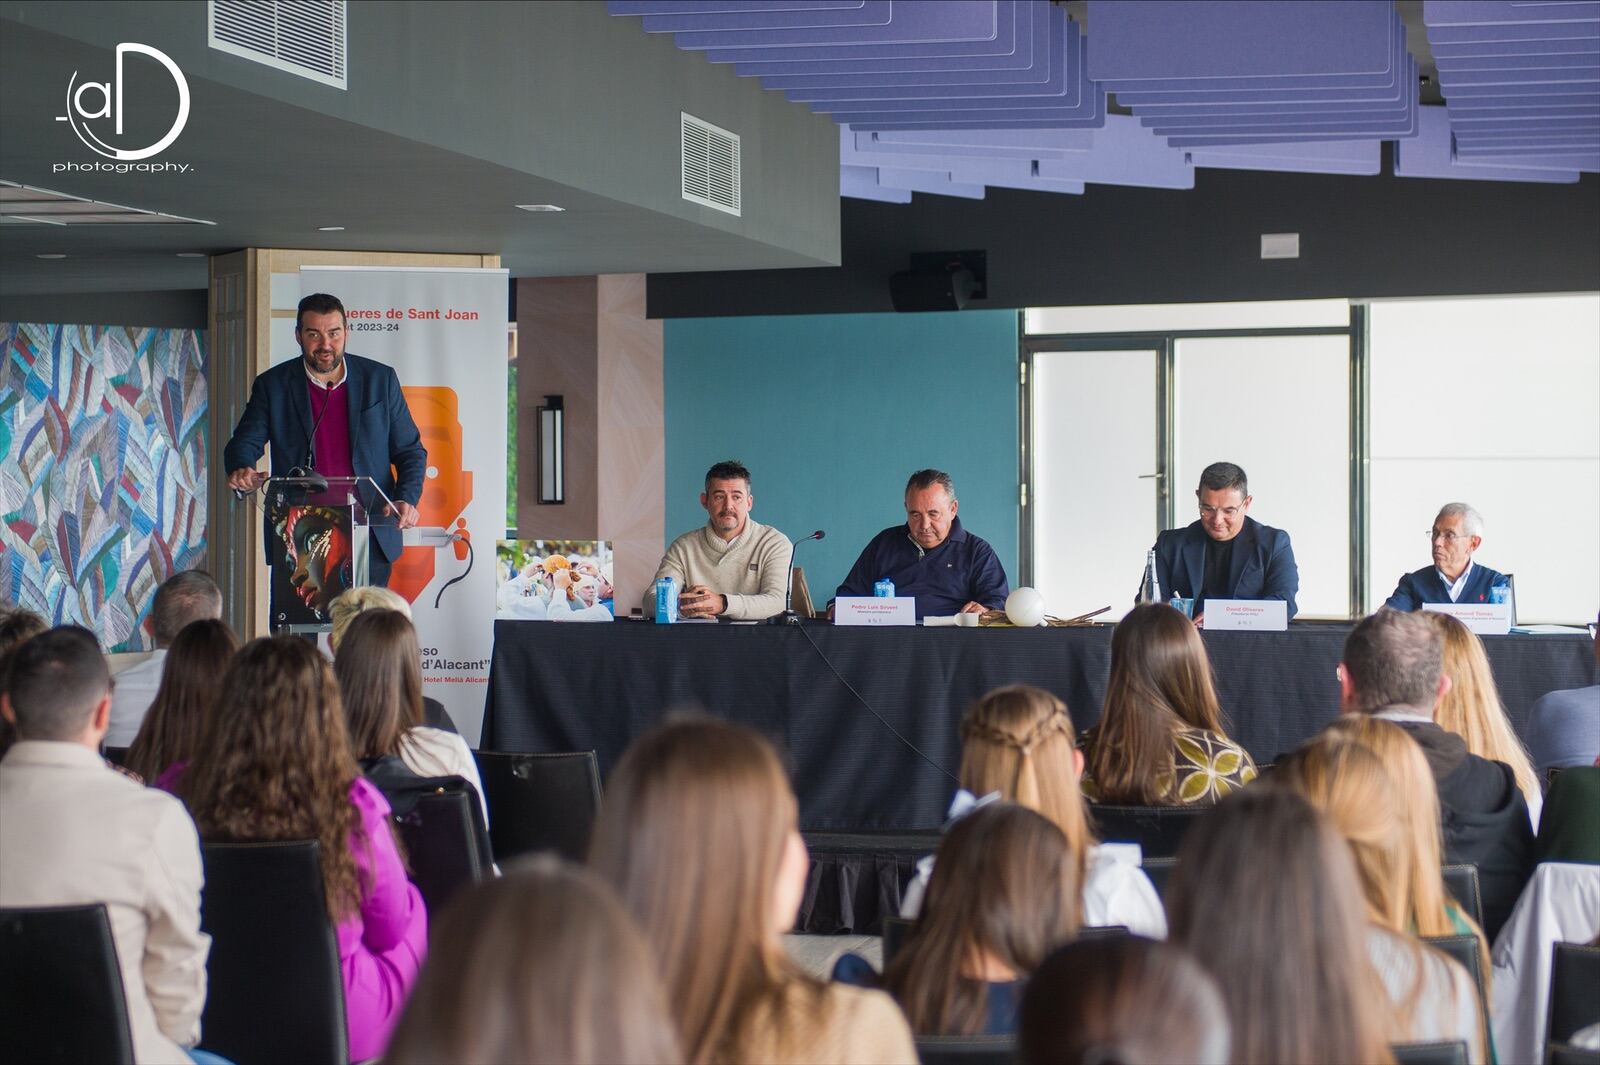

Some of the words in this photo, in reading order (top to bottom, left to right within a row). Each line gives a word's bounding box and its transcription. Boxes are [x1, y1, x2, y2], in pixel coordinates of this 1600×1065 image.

[386, 308, 403, 319] de
[407, 308, 440, 320] Sant
[444, 308, 479, 320] Joan
[356, 322, 399, 332] 2023-24
[423, 676, 443, 684] Hotel
